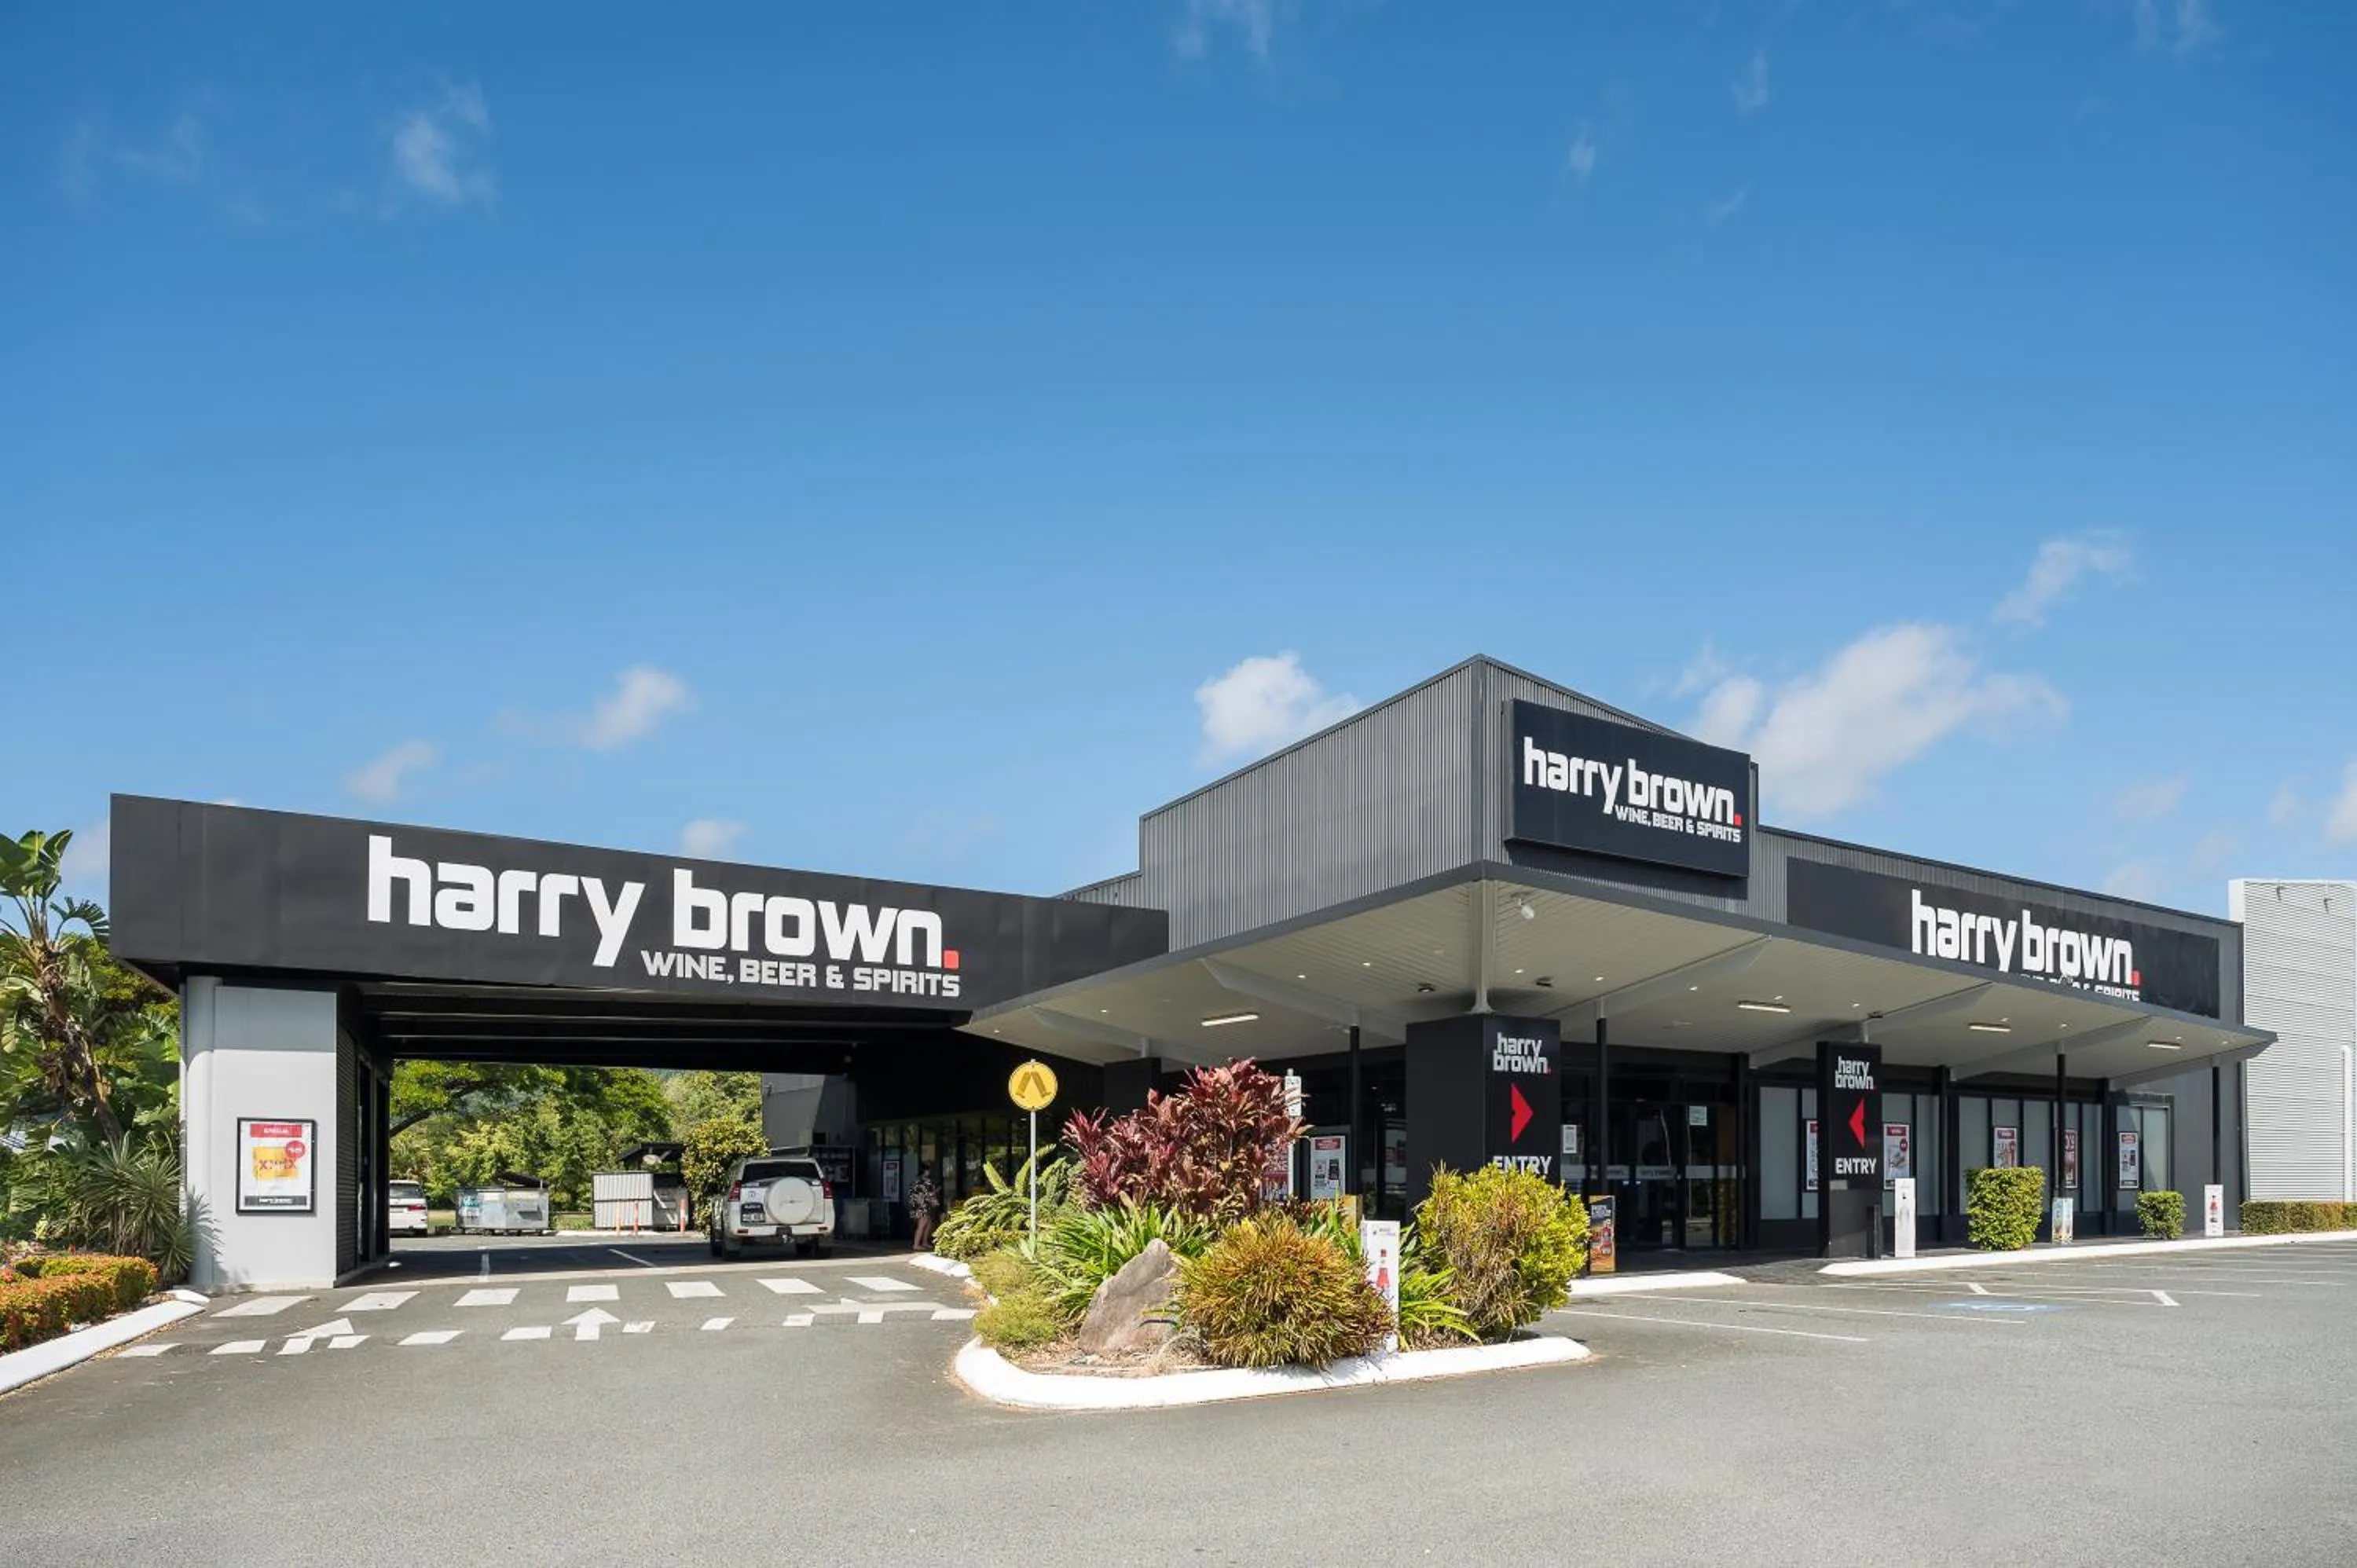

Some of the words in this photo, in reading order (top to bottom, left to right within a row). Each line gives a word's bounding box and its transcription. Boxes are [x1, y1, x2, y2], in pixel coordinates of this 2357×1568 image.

[1524, 736, 1622, 814] harry
[1628, 758, 1742, 826] brown.
[1615, 804, 1651, 826] WINE,
[1653, 811, 1683, 832] BEER
[1686, 819, 1695, 834] &
[1697, 822, 1741, 842] SPIRITS
[368, 835, 645, 967] harry
[673, 868, 959, 969] brown.
[1912, 888, 2018, 973] harry
[2022, 909, 2140, 986] brown.
[641, 950, 734, 984] WINE,
[740, 958, 817, 987] BEER
[826, 965, 845, 988] &
[853, 968, 960, 997] SPIRITS
[1497, 1032, 1542, 1058] harry
[1838, 1056, 1870, 1079] harry
[1835, 1158, 1877, 1174] ENTRY
